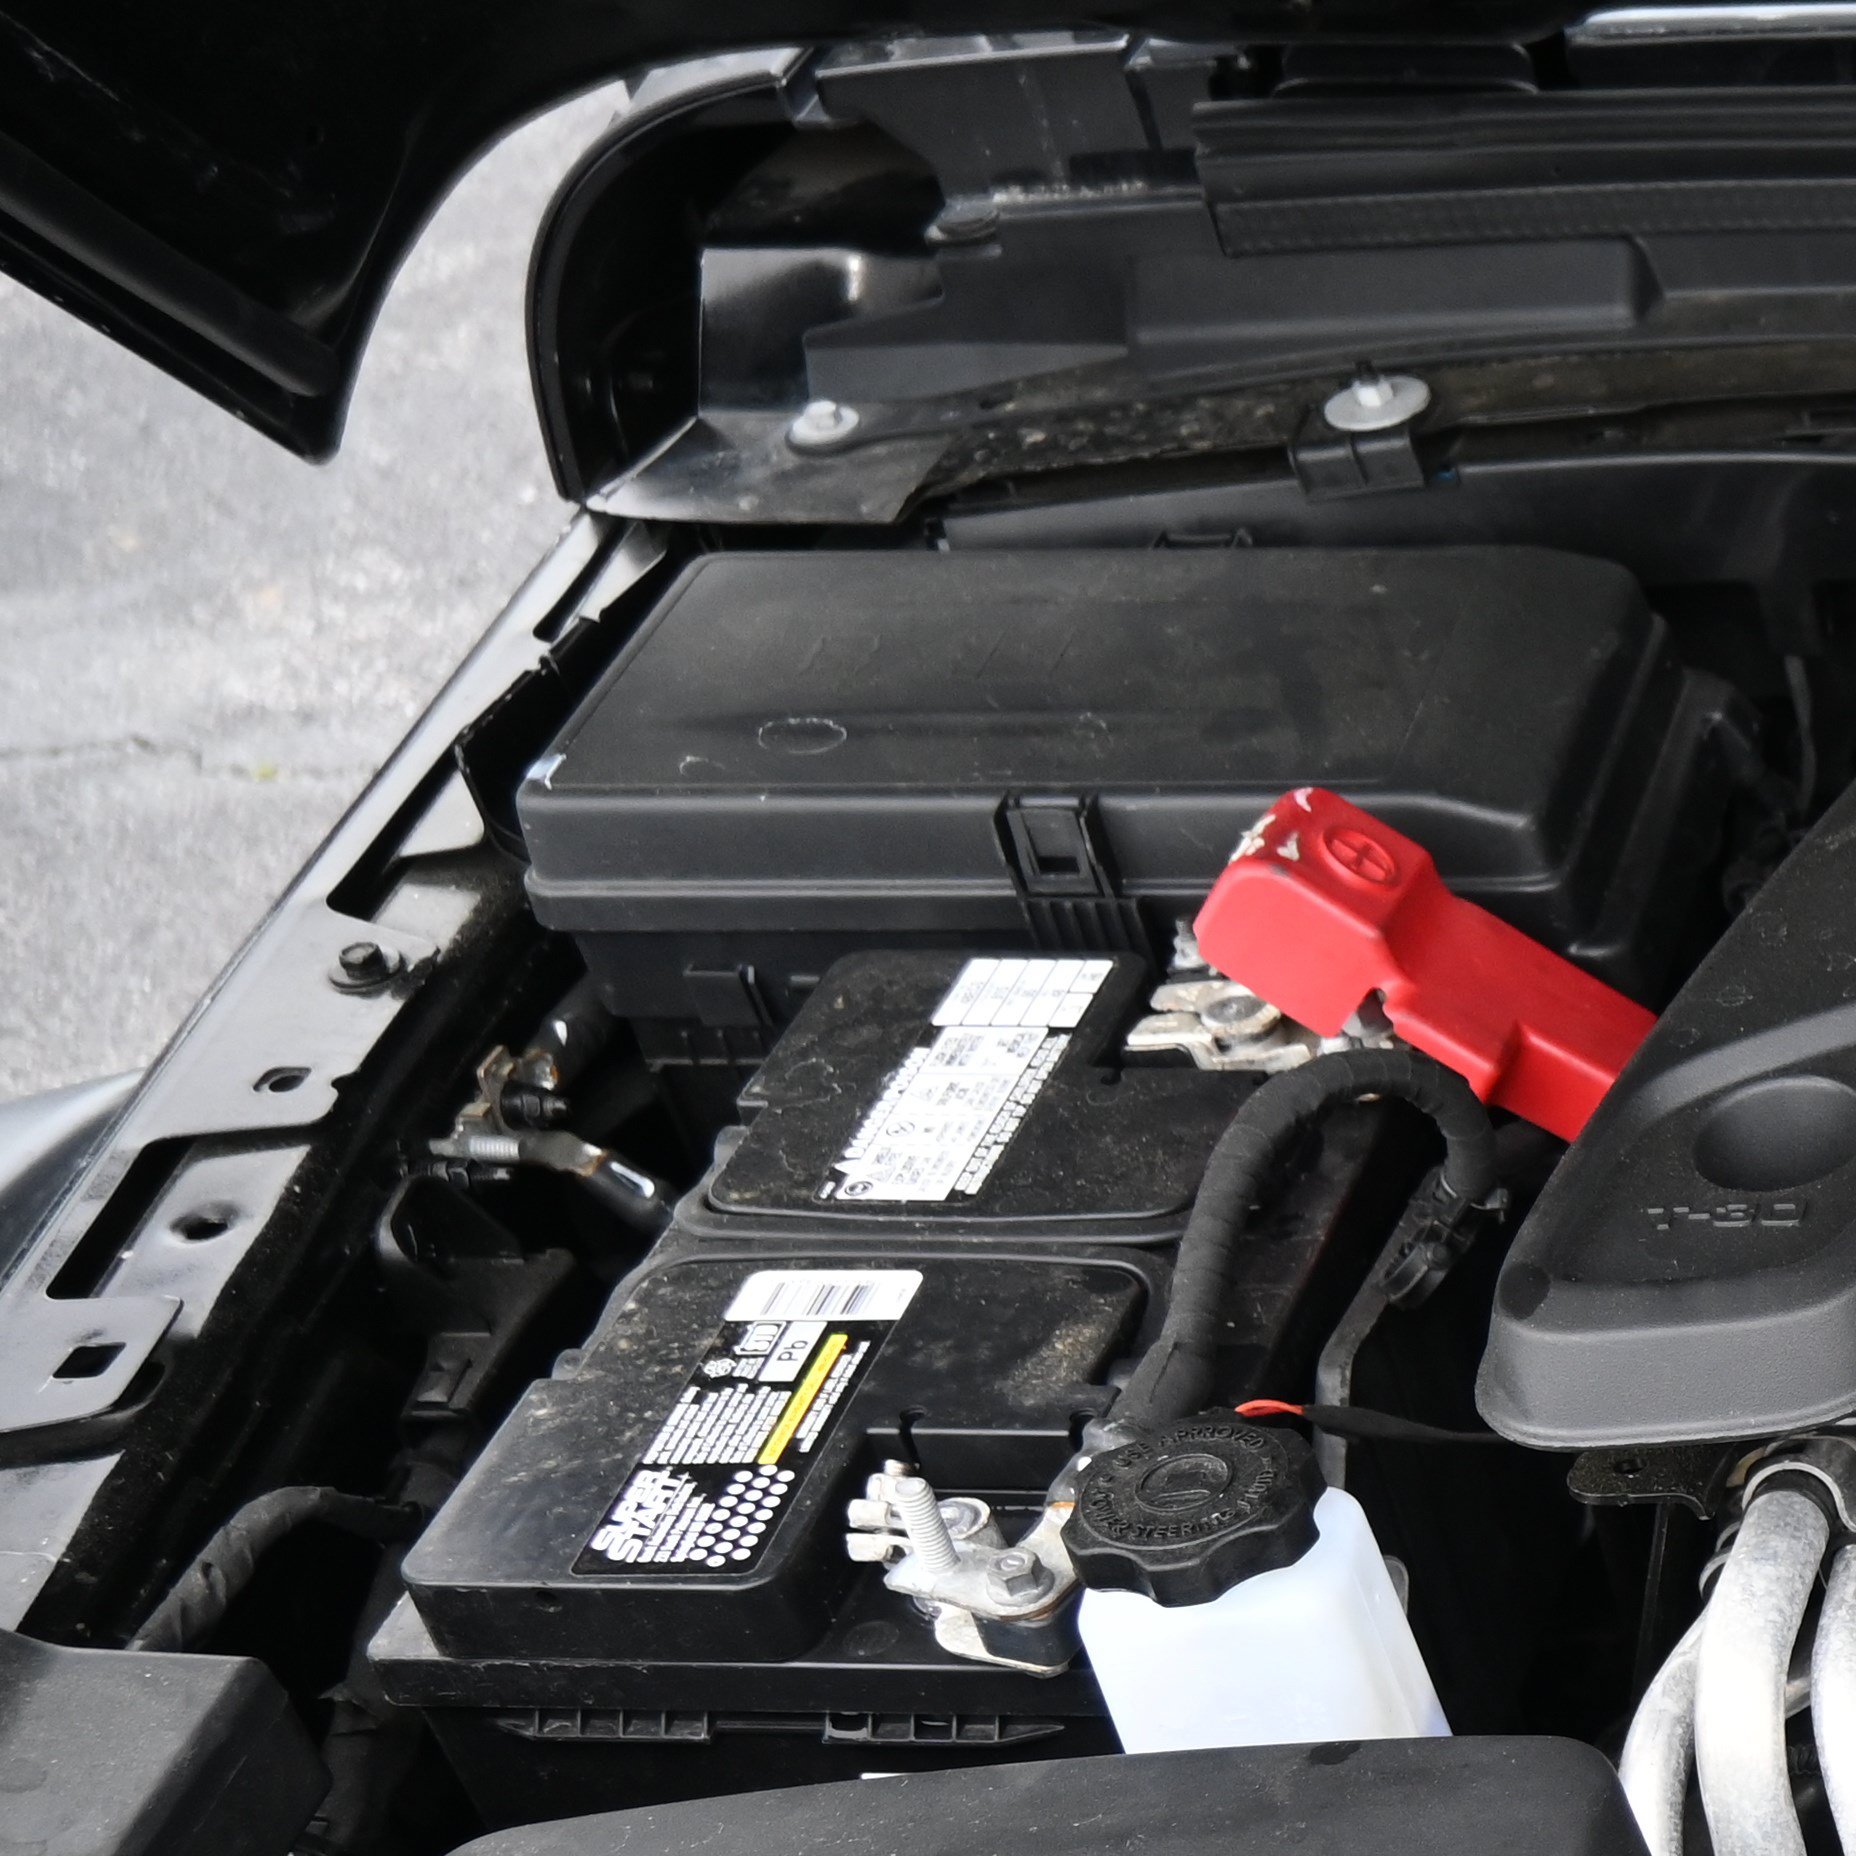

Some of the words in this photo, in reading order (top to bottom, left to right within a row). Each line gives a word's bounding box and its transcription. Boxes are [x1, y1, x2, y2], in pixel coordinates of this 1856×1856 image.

[777, 1339, 809, 1362] Pb
[590, 1469, 662, 1551] SUPER
[606, 1470, 682, 1563] START
